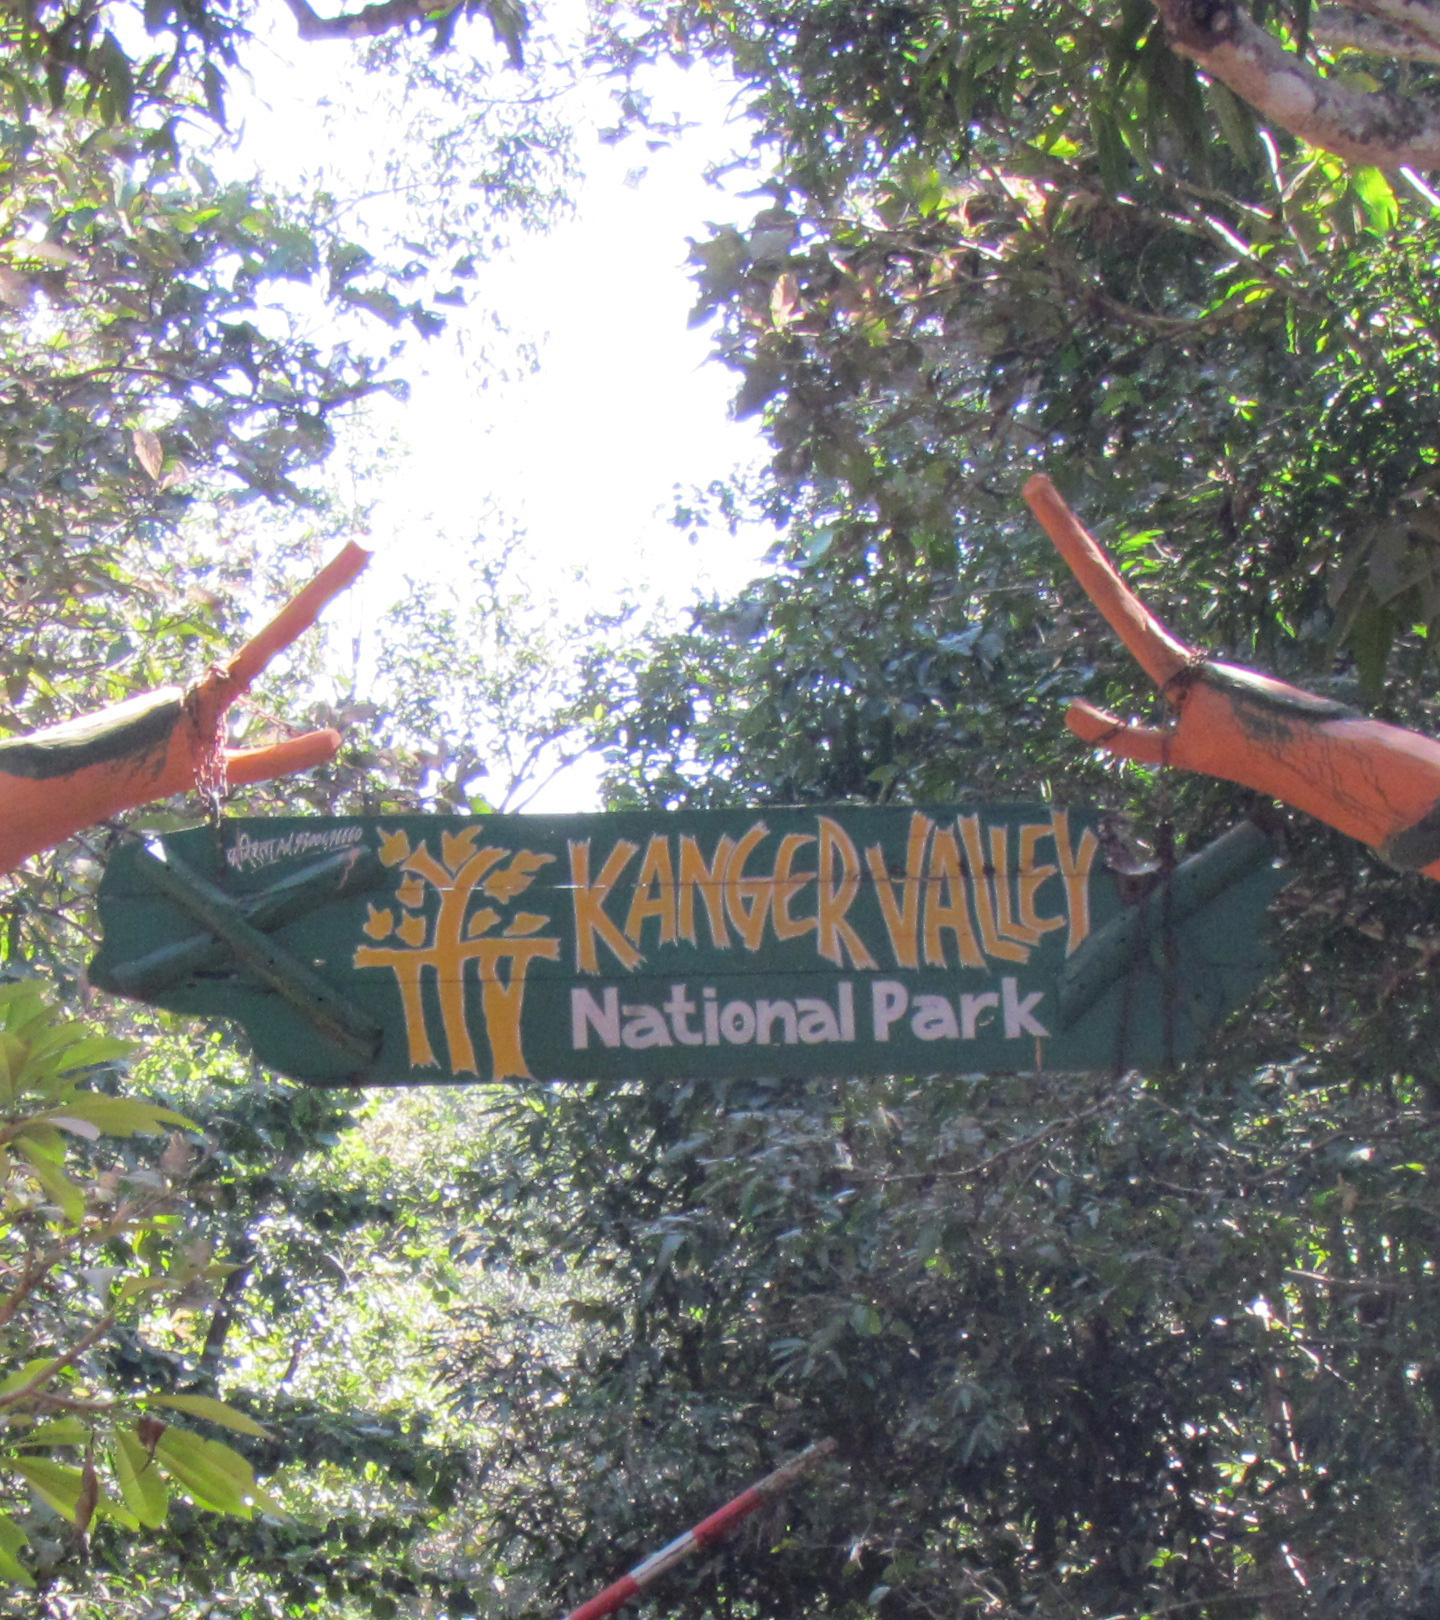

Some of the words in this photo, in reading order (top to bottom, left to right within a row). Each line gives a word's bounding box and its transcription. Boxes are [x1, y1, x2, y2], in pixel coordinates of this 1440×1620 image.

[567, 815, 878, 976] KANGER
[865, 807, 1100, 972] VALLEY
[571, 981, 856, 1050] National
[871, 977, 1051, 1041] Park
